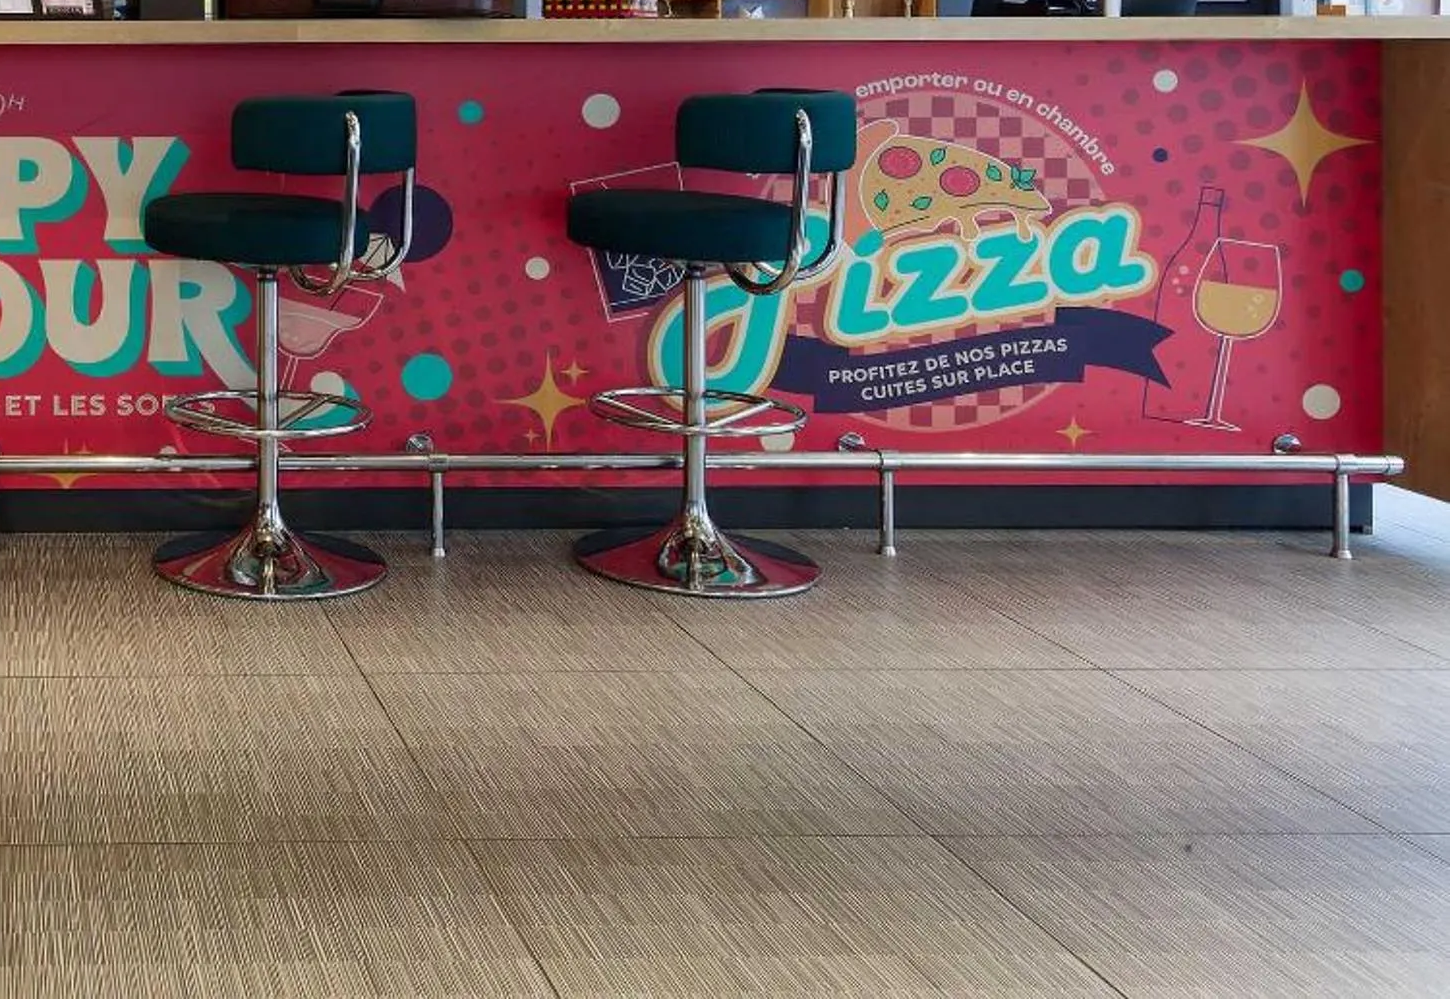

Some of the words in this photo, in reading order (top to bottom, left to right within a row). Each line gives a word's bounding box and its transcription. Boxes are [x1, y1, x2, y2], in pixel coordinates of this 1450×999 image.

[855, 72, 969, 98] emporter
[974, 78, 1002, 97] ou
[1006, 87, 1035, 108] en
[1035, 101, 1115, 176] chambre
[650, 204, 1157, 413] Pizza
[828, 361, 920, 384] PROFITEZ
[925, 356, 950, 372] DE
[954, 346, 996, 367] NOS
[1001, 338, 1068, 357] PIZZAS
[860, 381, 928, 402] CUITES
[932, 374, 970, 390] SUR
[974, 359, 1036, 382] PLACE
[5, 394, 41, 416] ET
[53, 394, 106, 416] LES
